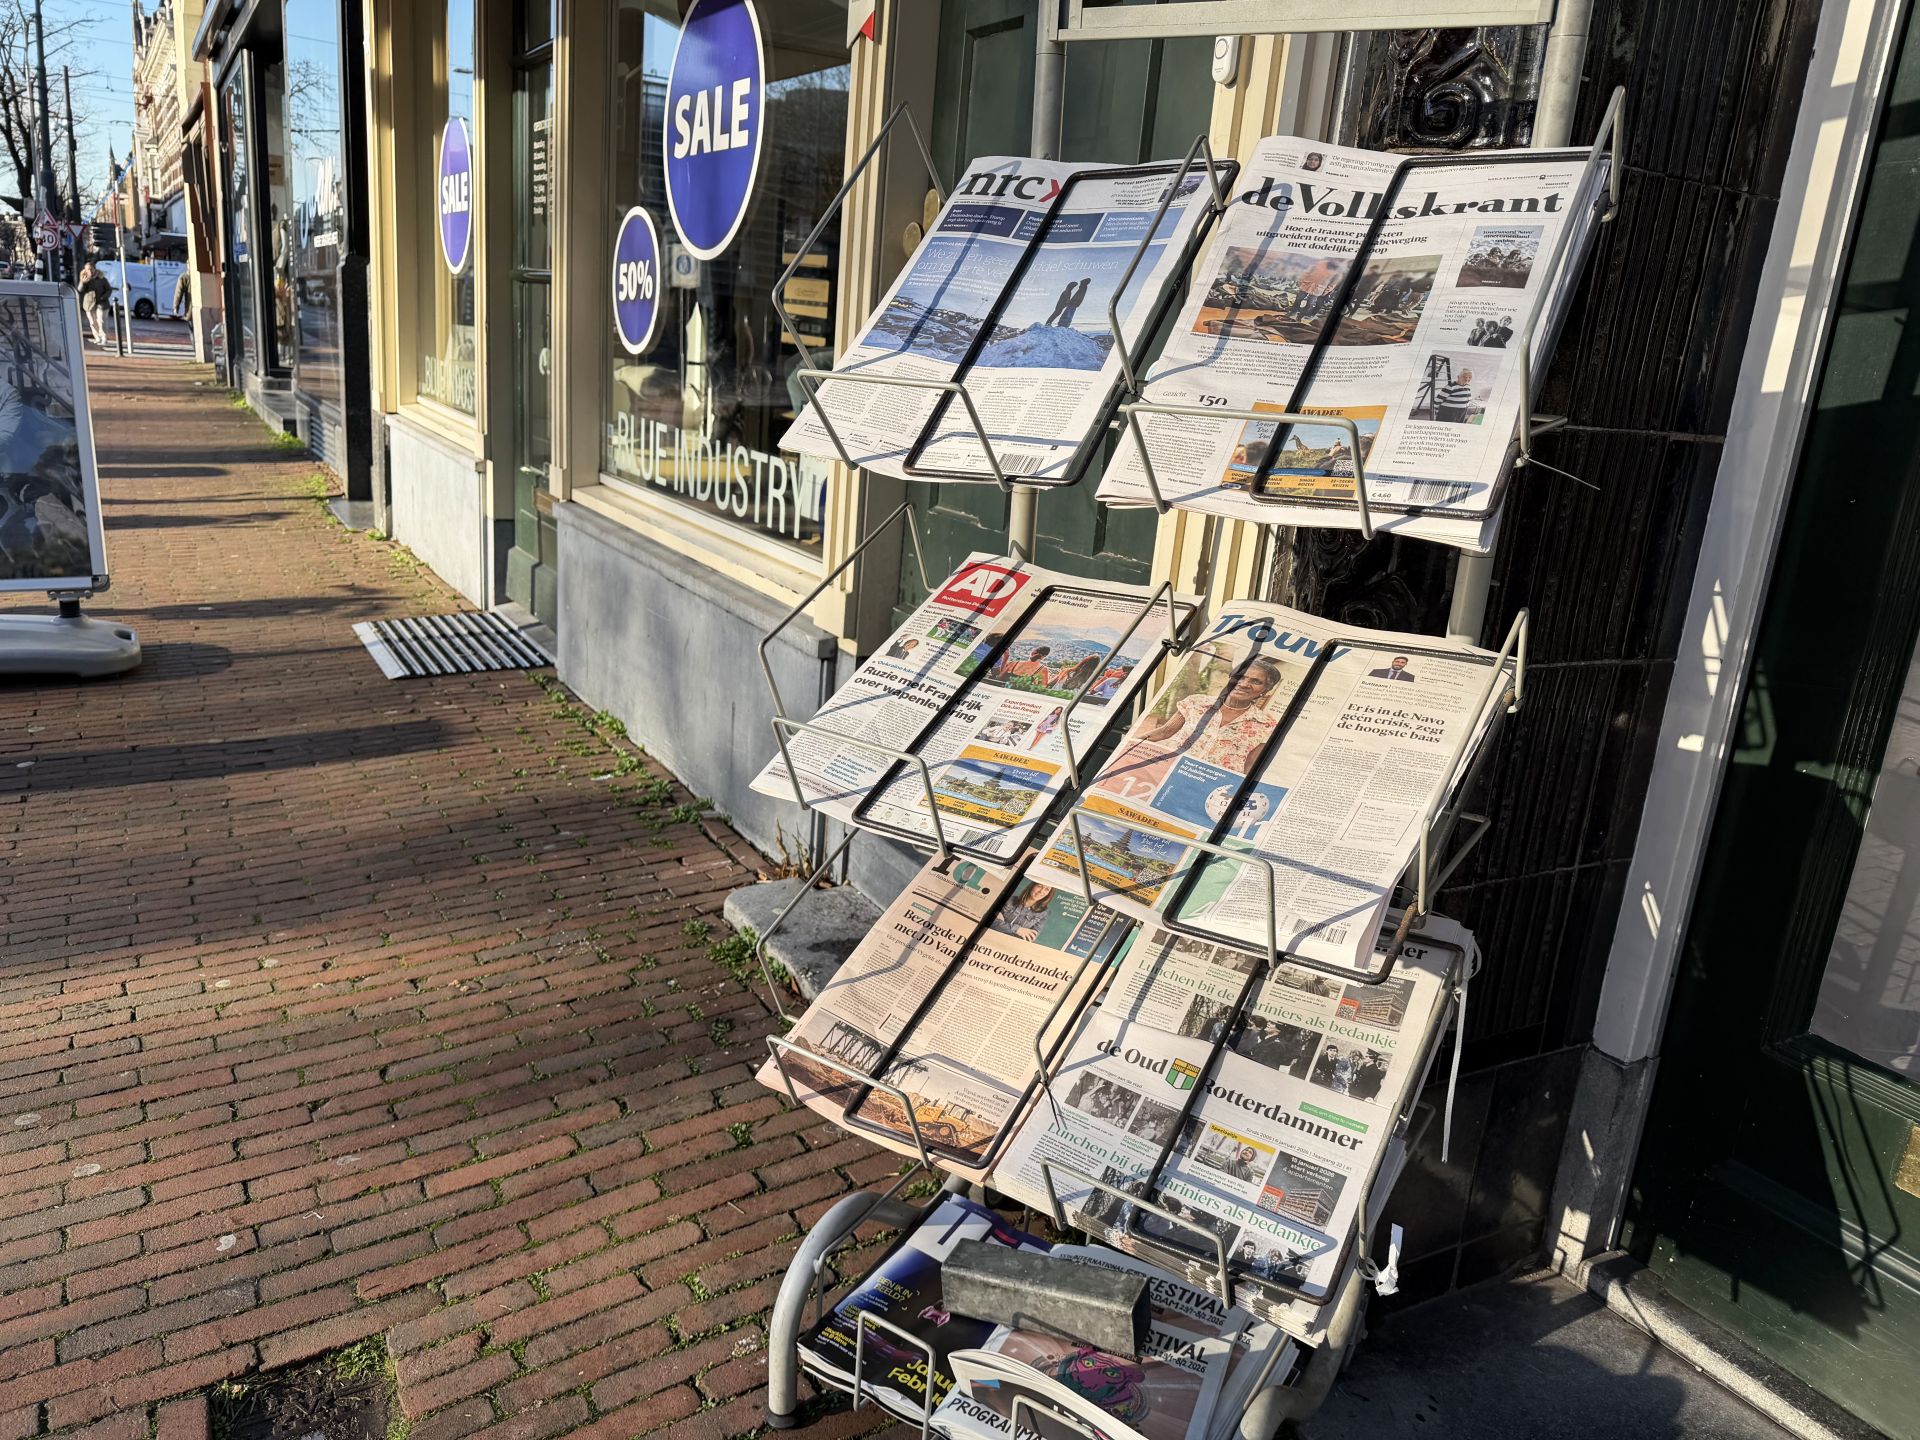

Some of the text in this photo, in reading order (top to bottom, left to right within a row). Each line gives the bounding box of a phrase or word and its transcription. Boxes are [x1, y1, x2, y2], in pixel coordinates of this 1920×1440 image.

[673, 77, 752, 160] SALE
[441, 171, 469, 214] SALE
[959, 172, 1046, 200] nrc
[1256, 230, 1311, 241] uitgroeiden
[1314, 234, 1328, 242] tot
[1330, 236, 1346, 244] een
[1284, 225, 1304, 233] Hoe
[1318, 228, 1355, 236] Iraanse
[1287, 240, 1307, 249] met
[1308, 242, 1354, 253] dodelijke
[619, 259, 653, 301] 50%
[617, 411, 804, 540] BLUE INDUSTRY
[947, 568, 1017, 600] AD
[942, 595, 972, 606] Rotterdams
[1058, 599, 1089, 608] vakantie
[1062, 594, 1093, 604] snakken
[1211, 614, 1352, 662] Trouw
[863, 666, 900, 682] Ruzie
[897, 677, 927, 691] met
[855, 677, 883, 690] over
[883, 685, 978, 724] wapenlevring
[1340, 712, 1446, 735] géén crisis, zegt
[1347, 703, 1445, 726] Er is in de Navo
[1337, 721, 1441, 743] de hoogste baas
[993, 751, 1030, 765] SAWADEE
[1119, 776, 1156, 801] 12
[1118, 807, 1160, 828] SAWADEE
[894, 922, 1058, 992] met JD Vane over Groenland
[903, 909, 958, 941] Bezorgde
[954, 934, 993, 955] Dnen
[993, 951, 1076, 982] onderhandele
[1138, 960, 1235, 1001] Lunchen bij de
[1247, 1000, 1398, 1050] ariniers als bedankje
[1097, 1039, 1363, 1152] de Oud Rotterdammer
[1048, 1122, 1108, 1158] Lunchen
[1110, 1150, 1130, 1169] bij
[1131, 1162, 1149, 1177] de
[1246, 1127, 1260, 1136] Sinds
[1278, 1139, 1297, 1150] januari
[1290, 1163, 1331, 1182] start verkoop
[1297, 1159, 1336, 1178] januari 2026
[1287, 1170, 1334, 1191] appartementen
[1223, 1203, 1245, 1221] als
[1248, 1212, 1322, 1252] bedankje
[1073, 1254, 1124, 1273] INTERNATIONAL
[877, 1276, 895, 1288] BEN
[902, 1288, 913, 1299] IN
[1149, 1276, 1228, 1319] FESTIVAL
[1207, 1315, 1225, 1326] 2026
[824, 1326, 857, 1346] Blockbuster
[1144, 1328, 1208, 1365] STIVAL
[1188, 1361, 1207, 1374] 2026
